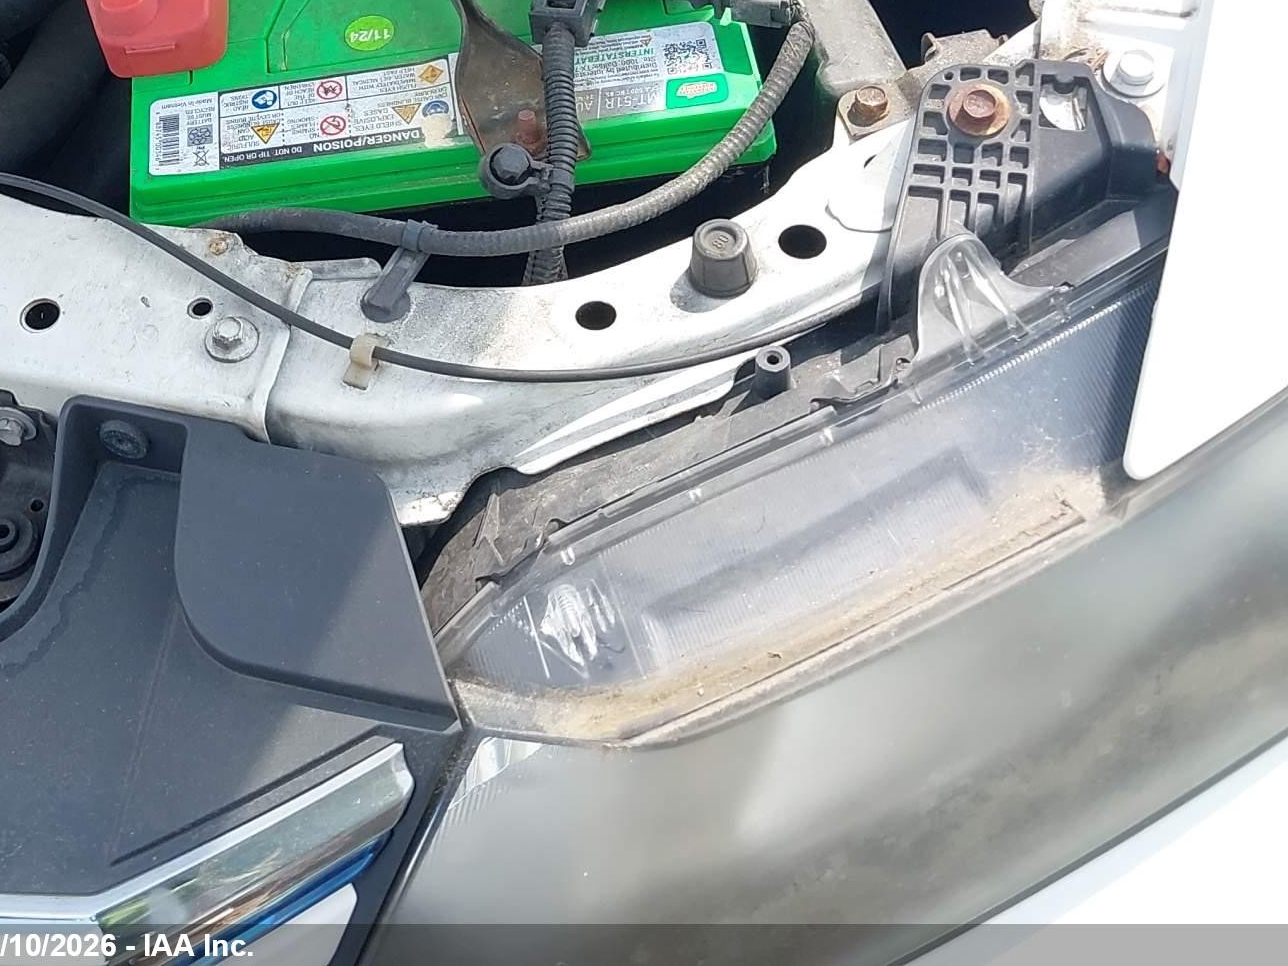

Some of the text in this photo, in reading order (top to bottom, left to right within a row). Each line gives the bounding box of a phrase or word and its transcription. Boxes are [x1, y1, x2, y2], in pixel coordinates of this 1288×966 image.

[350, 28, 391, 43] 11/24
[616, 62, 657, 73] Distributed
[605, 92, 658, 109] MT-51R
[353, 115, 394, 124] EXPLOSIVE
[376, 120, 402, 128] SHIELD
[313, 129, 420, 152] DANGER/POISON
[226, 141, 260, 150] SULFURIC
[246, 153, 256, 161] OR
[274, 148, 290, 157] NOT
